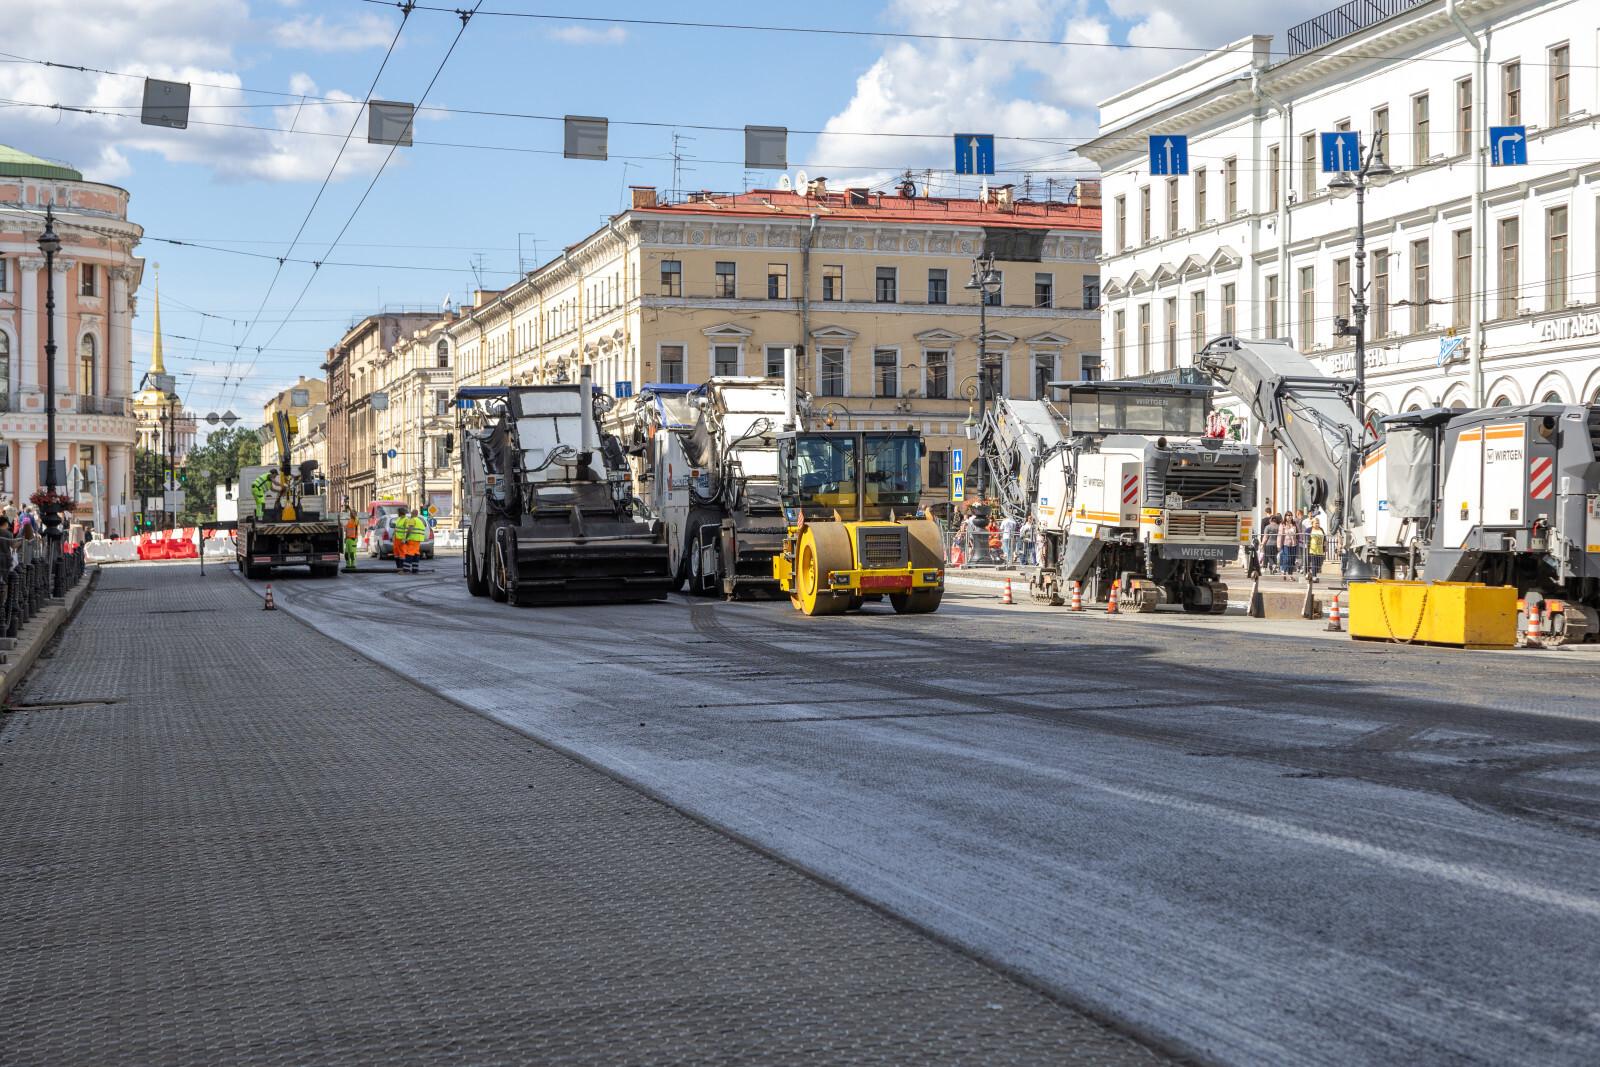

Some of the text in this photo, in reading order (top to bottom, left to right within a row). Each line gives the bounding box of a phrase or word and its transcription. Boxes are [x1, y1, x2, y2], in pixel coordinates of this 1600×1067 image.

[1538, 317, 1570, 341] ZENIT
[1362, 347, 1387, 369] РЕНА
[1495, 449, 1523, 461] WIRTGEN
[1181, 547, 1224, 557] WIRTGEN
